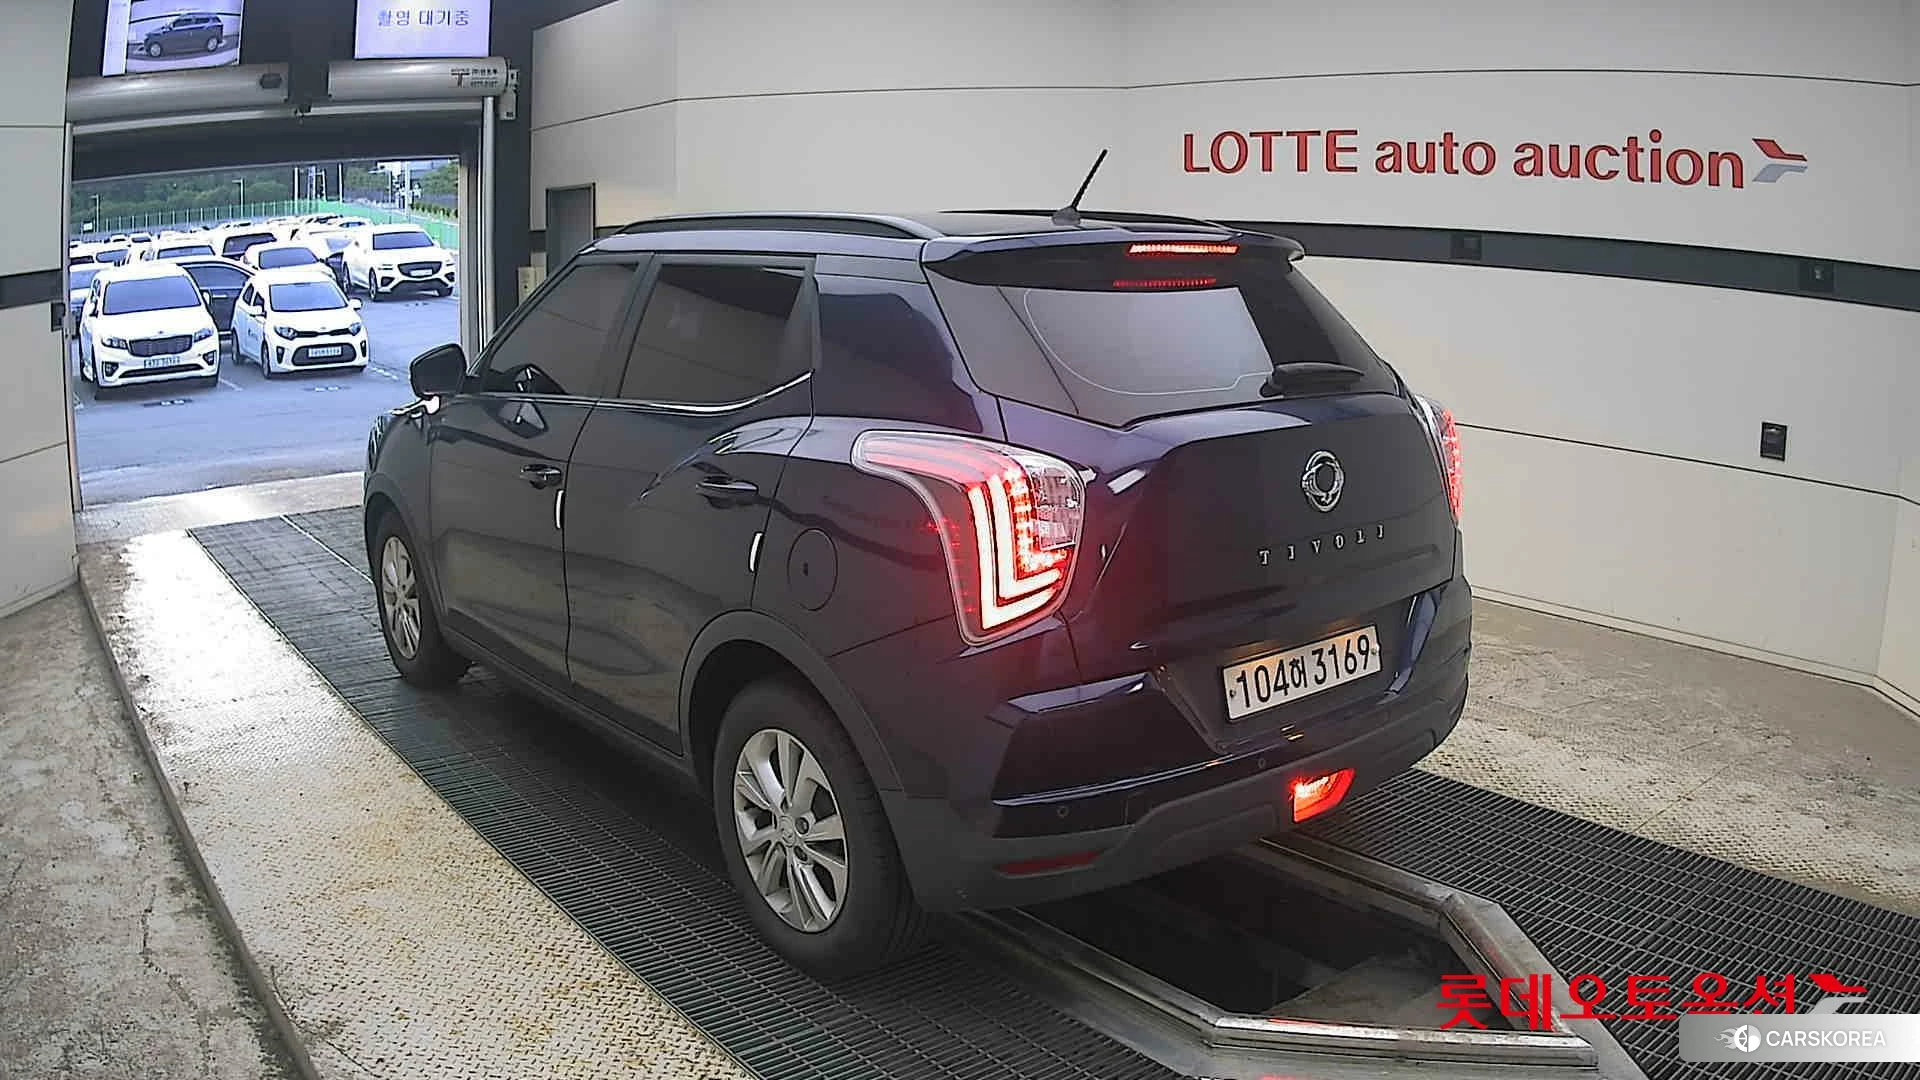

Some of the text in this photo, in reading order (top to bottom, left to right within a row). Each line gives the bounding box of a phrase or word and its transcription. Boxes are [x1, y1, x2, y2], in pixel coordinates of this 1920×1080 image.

[419, 10, 469, 26] 대기중
[1183, 129, 1745, 189] LOTTE auto auction
[1258, 524, 1385, 566] TIVOLI
